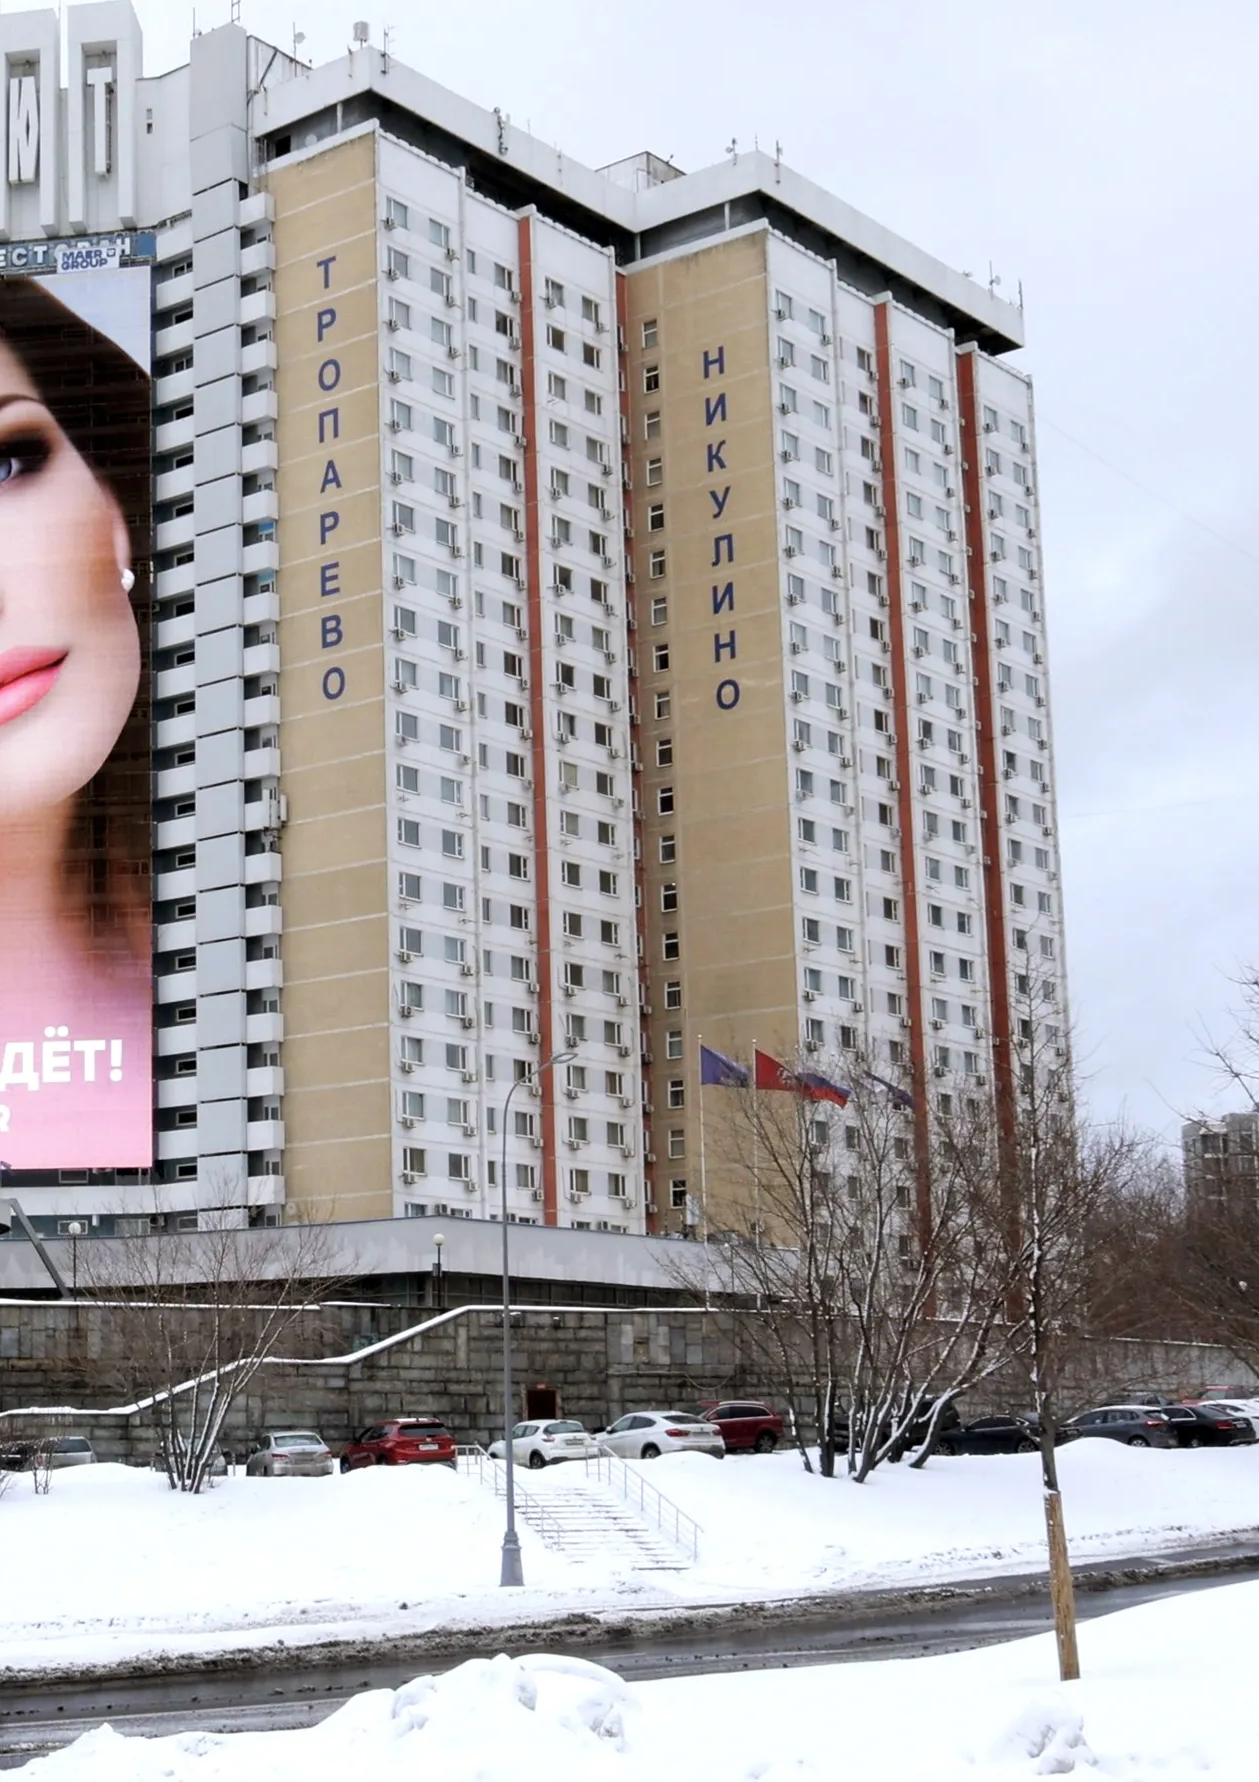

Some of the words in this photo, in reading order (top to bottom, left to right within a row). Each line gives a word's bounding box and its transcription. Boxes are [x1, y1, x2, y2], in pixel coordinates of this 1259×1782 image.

[60, 258, 109, 271] GROUP
[61, 248, 103, 262] MAER
[316, 255, 345, 701] ТРОПАРЕВО
[702, 345, 741, 711] НИКУЛИНО
